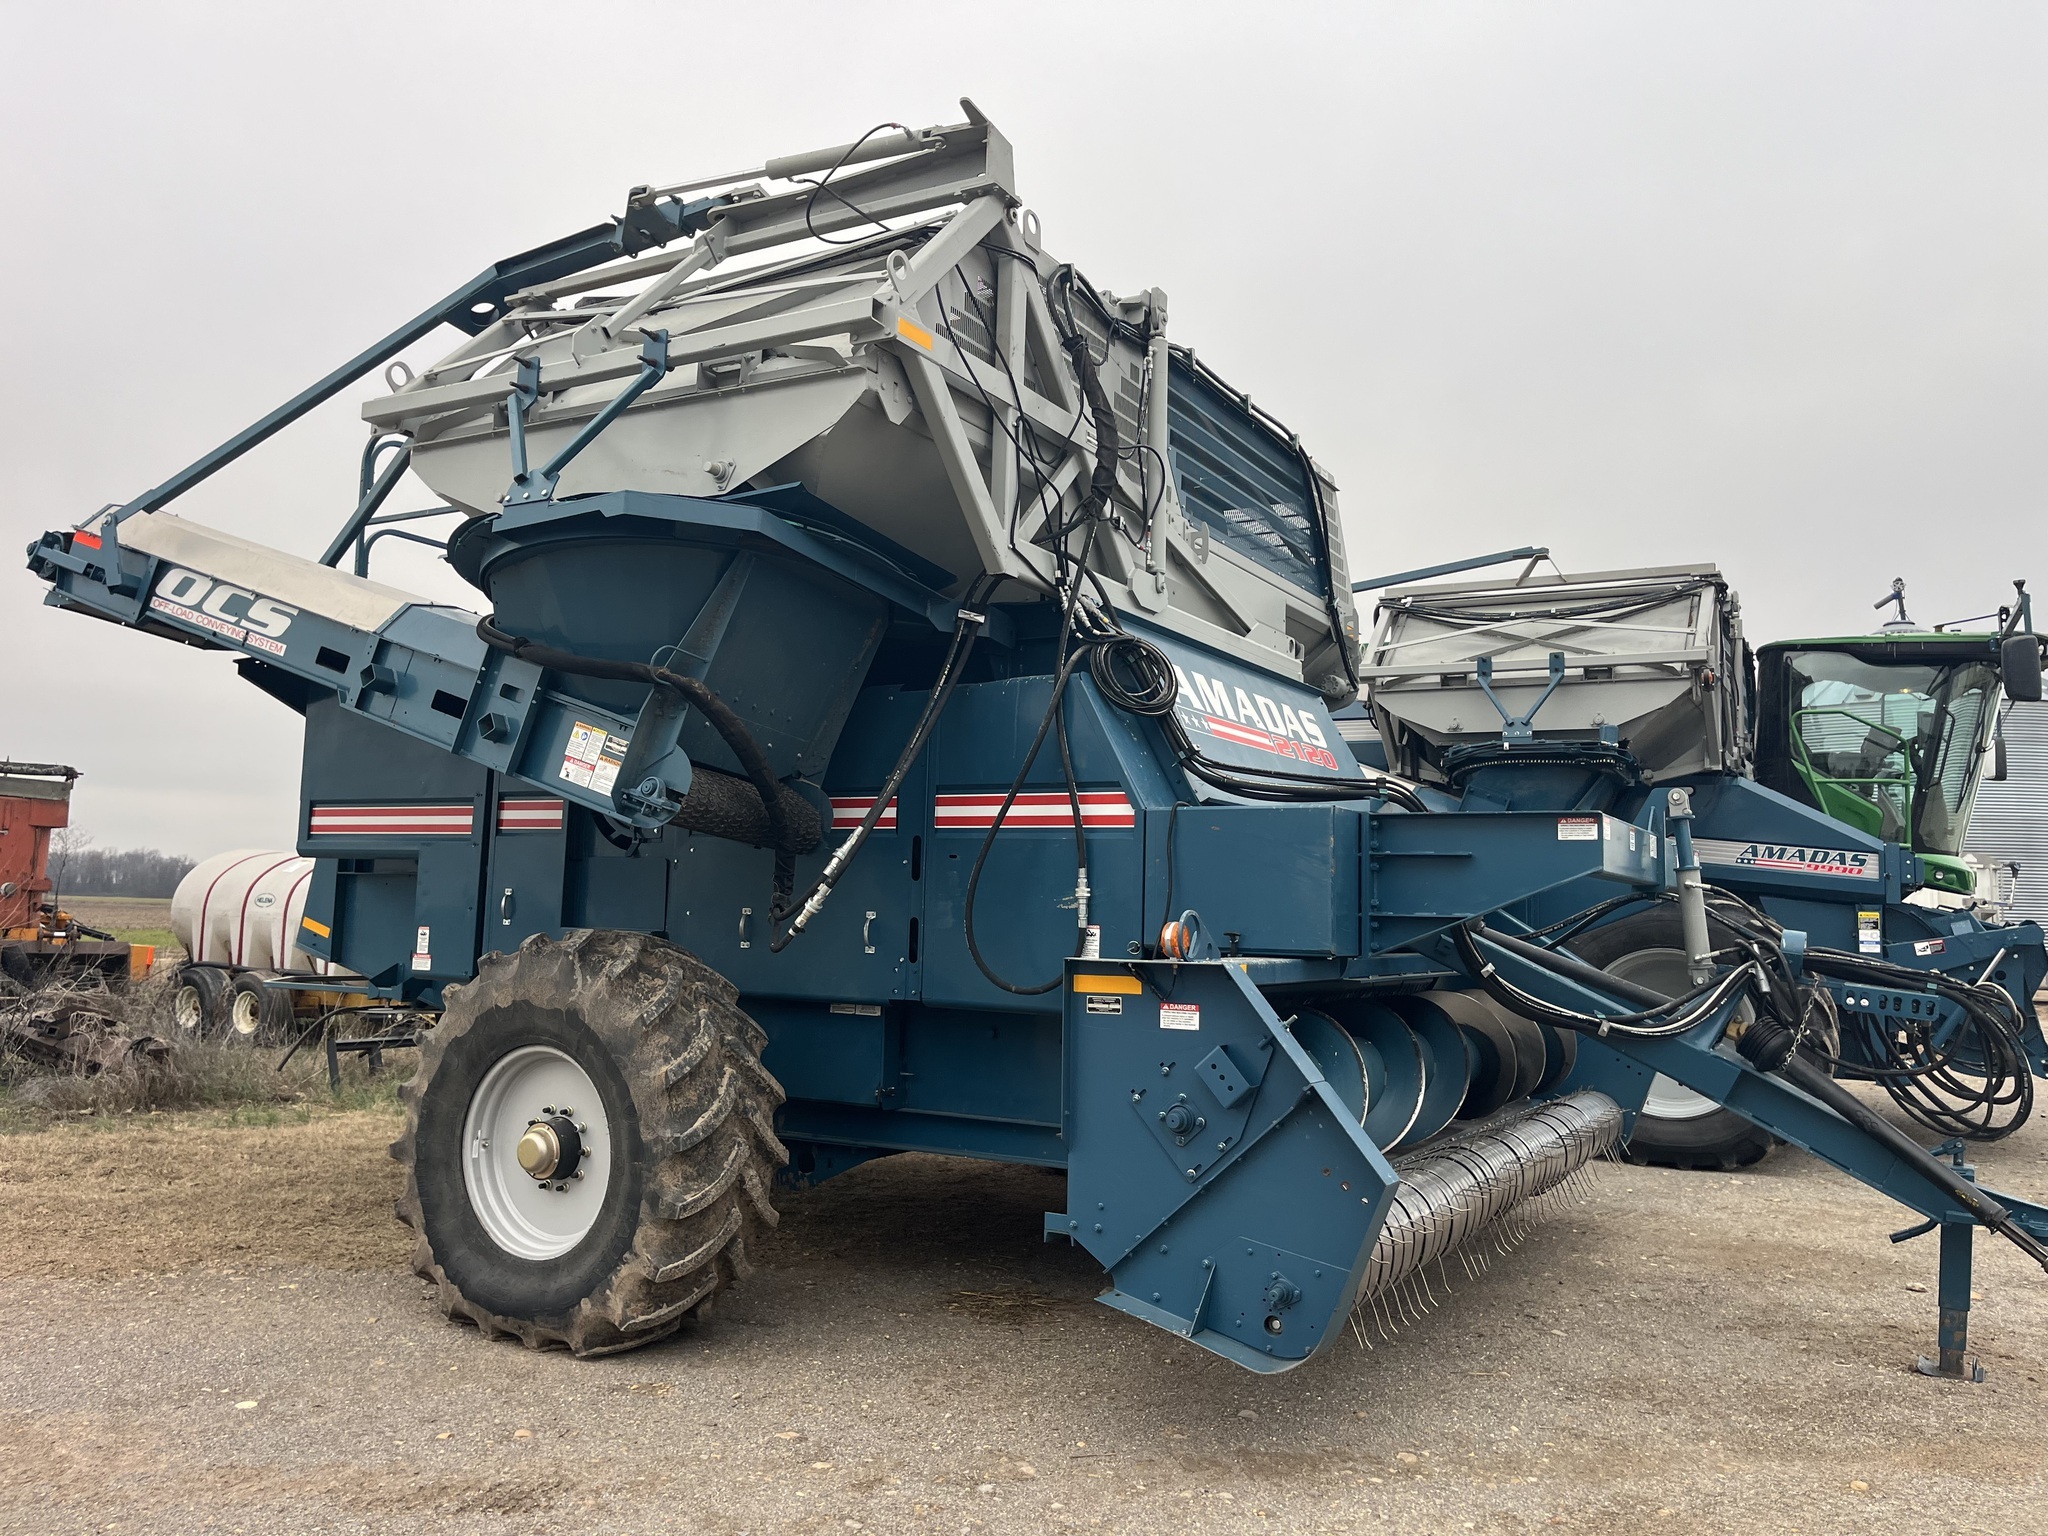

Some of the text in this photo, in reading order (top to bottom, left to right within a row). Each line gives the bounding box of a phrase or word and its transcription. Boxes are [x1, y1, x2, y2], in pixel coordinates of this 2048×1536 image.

[155, 568, 300, 638] OCS
[152, 598, 284, 654] OFF-LOAD CONVEYING SYSTEM
[1173, 663, 1328, 749] AMADAS
[1272, 735, 1339, 771] 2120
[1739, 844, 1869, 868] AMADAS
[1806, 863, 1863, 875] 9990
[1169, 1003, 1196, 1011] DANGER
